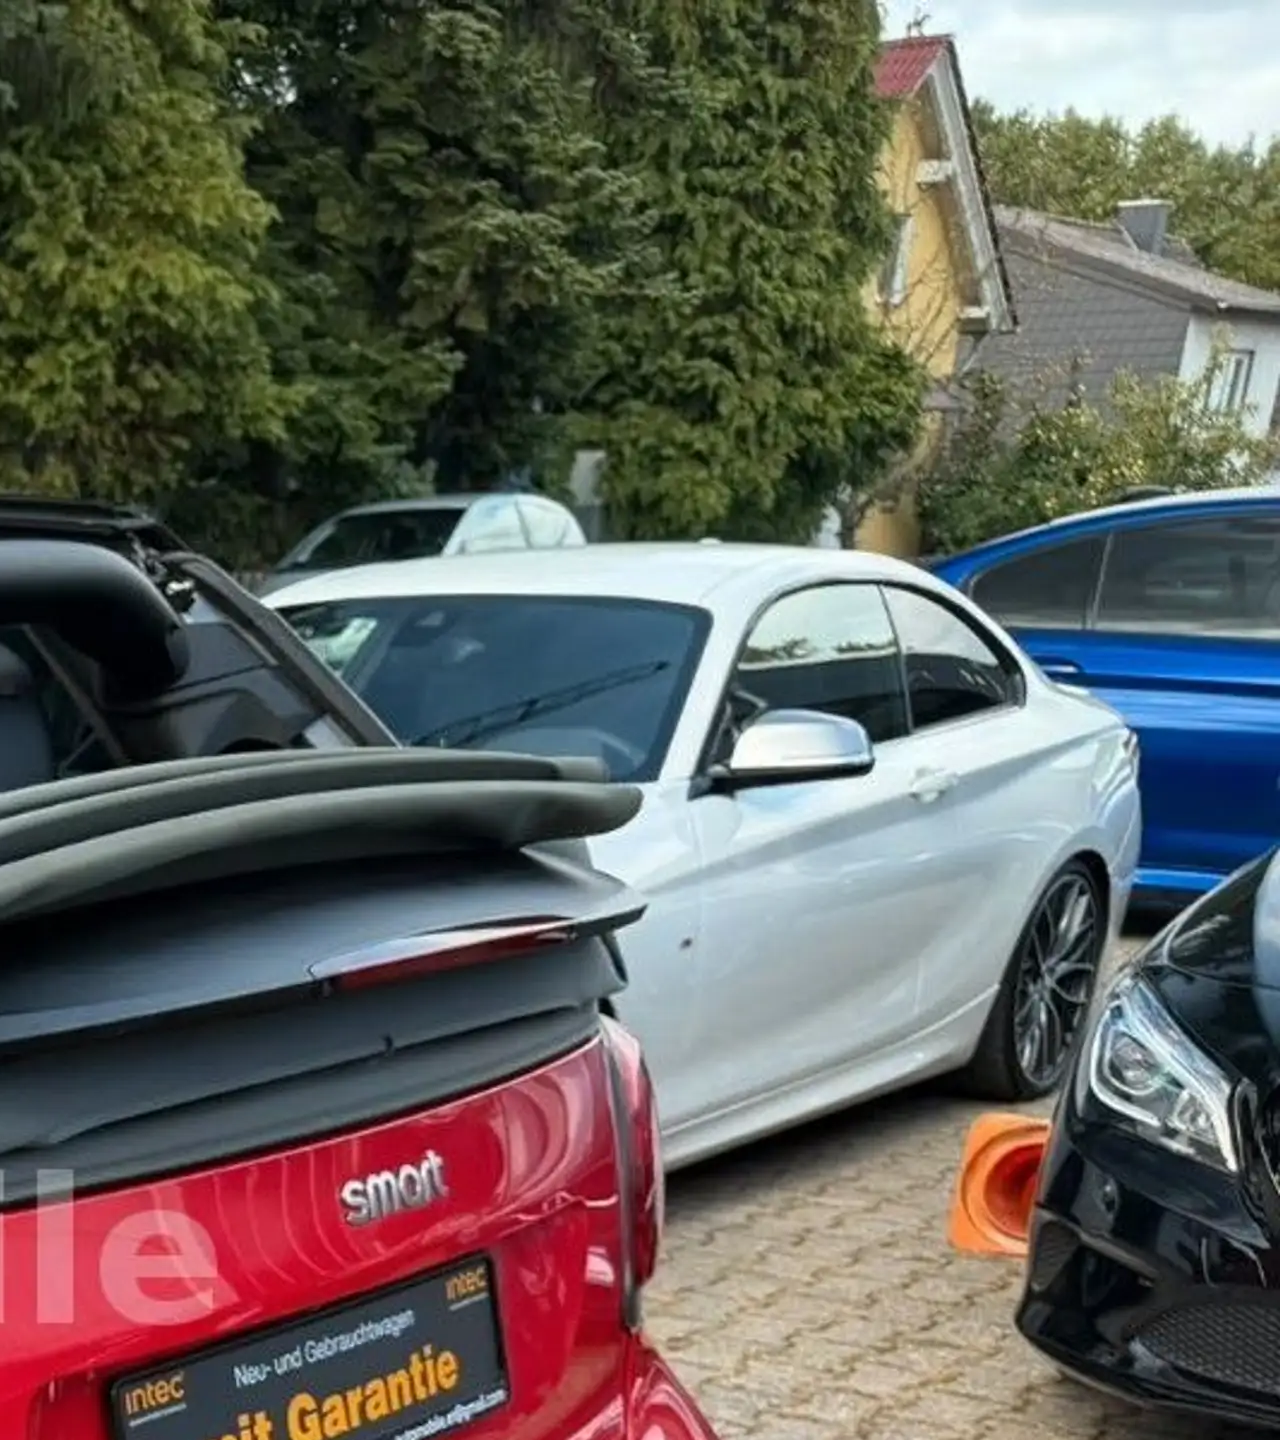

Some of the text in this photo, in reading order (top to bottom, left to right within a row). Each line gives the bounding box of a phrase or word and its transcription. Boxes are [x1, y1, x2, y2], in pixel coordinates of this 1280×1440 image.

[341, 1149, 449, 1227] smart
[446, 1266, 488, 1300] intec
[233, 1309, 416, 1388] Neu- und Gebrauchtwagen
[125, 1371, 186, 1415] intec
